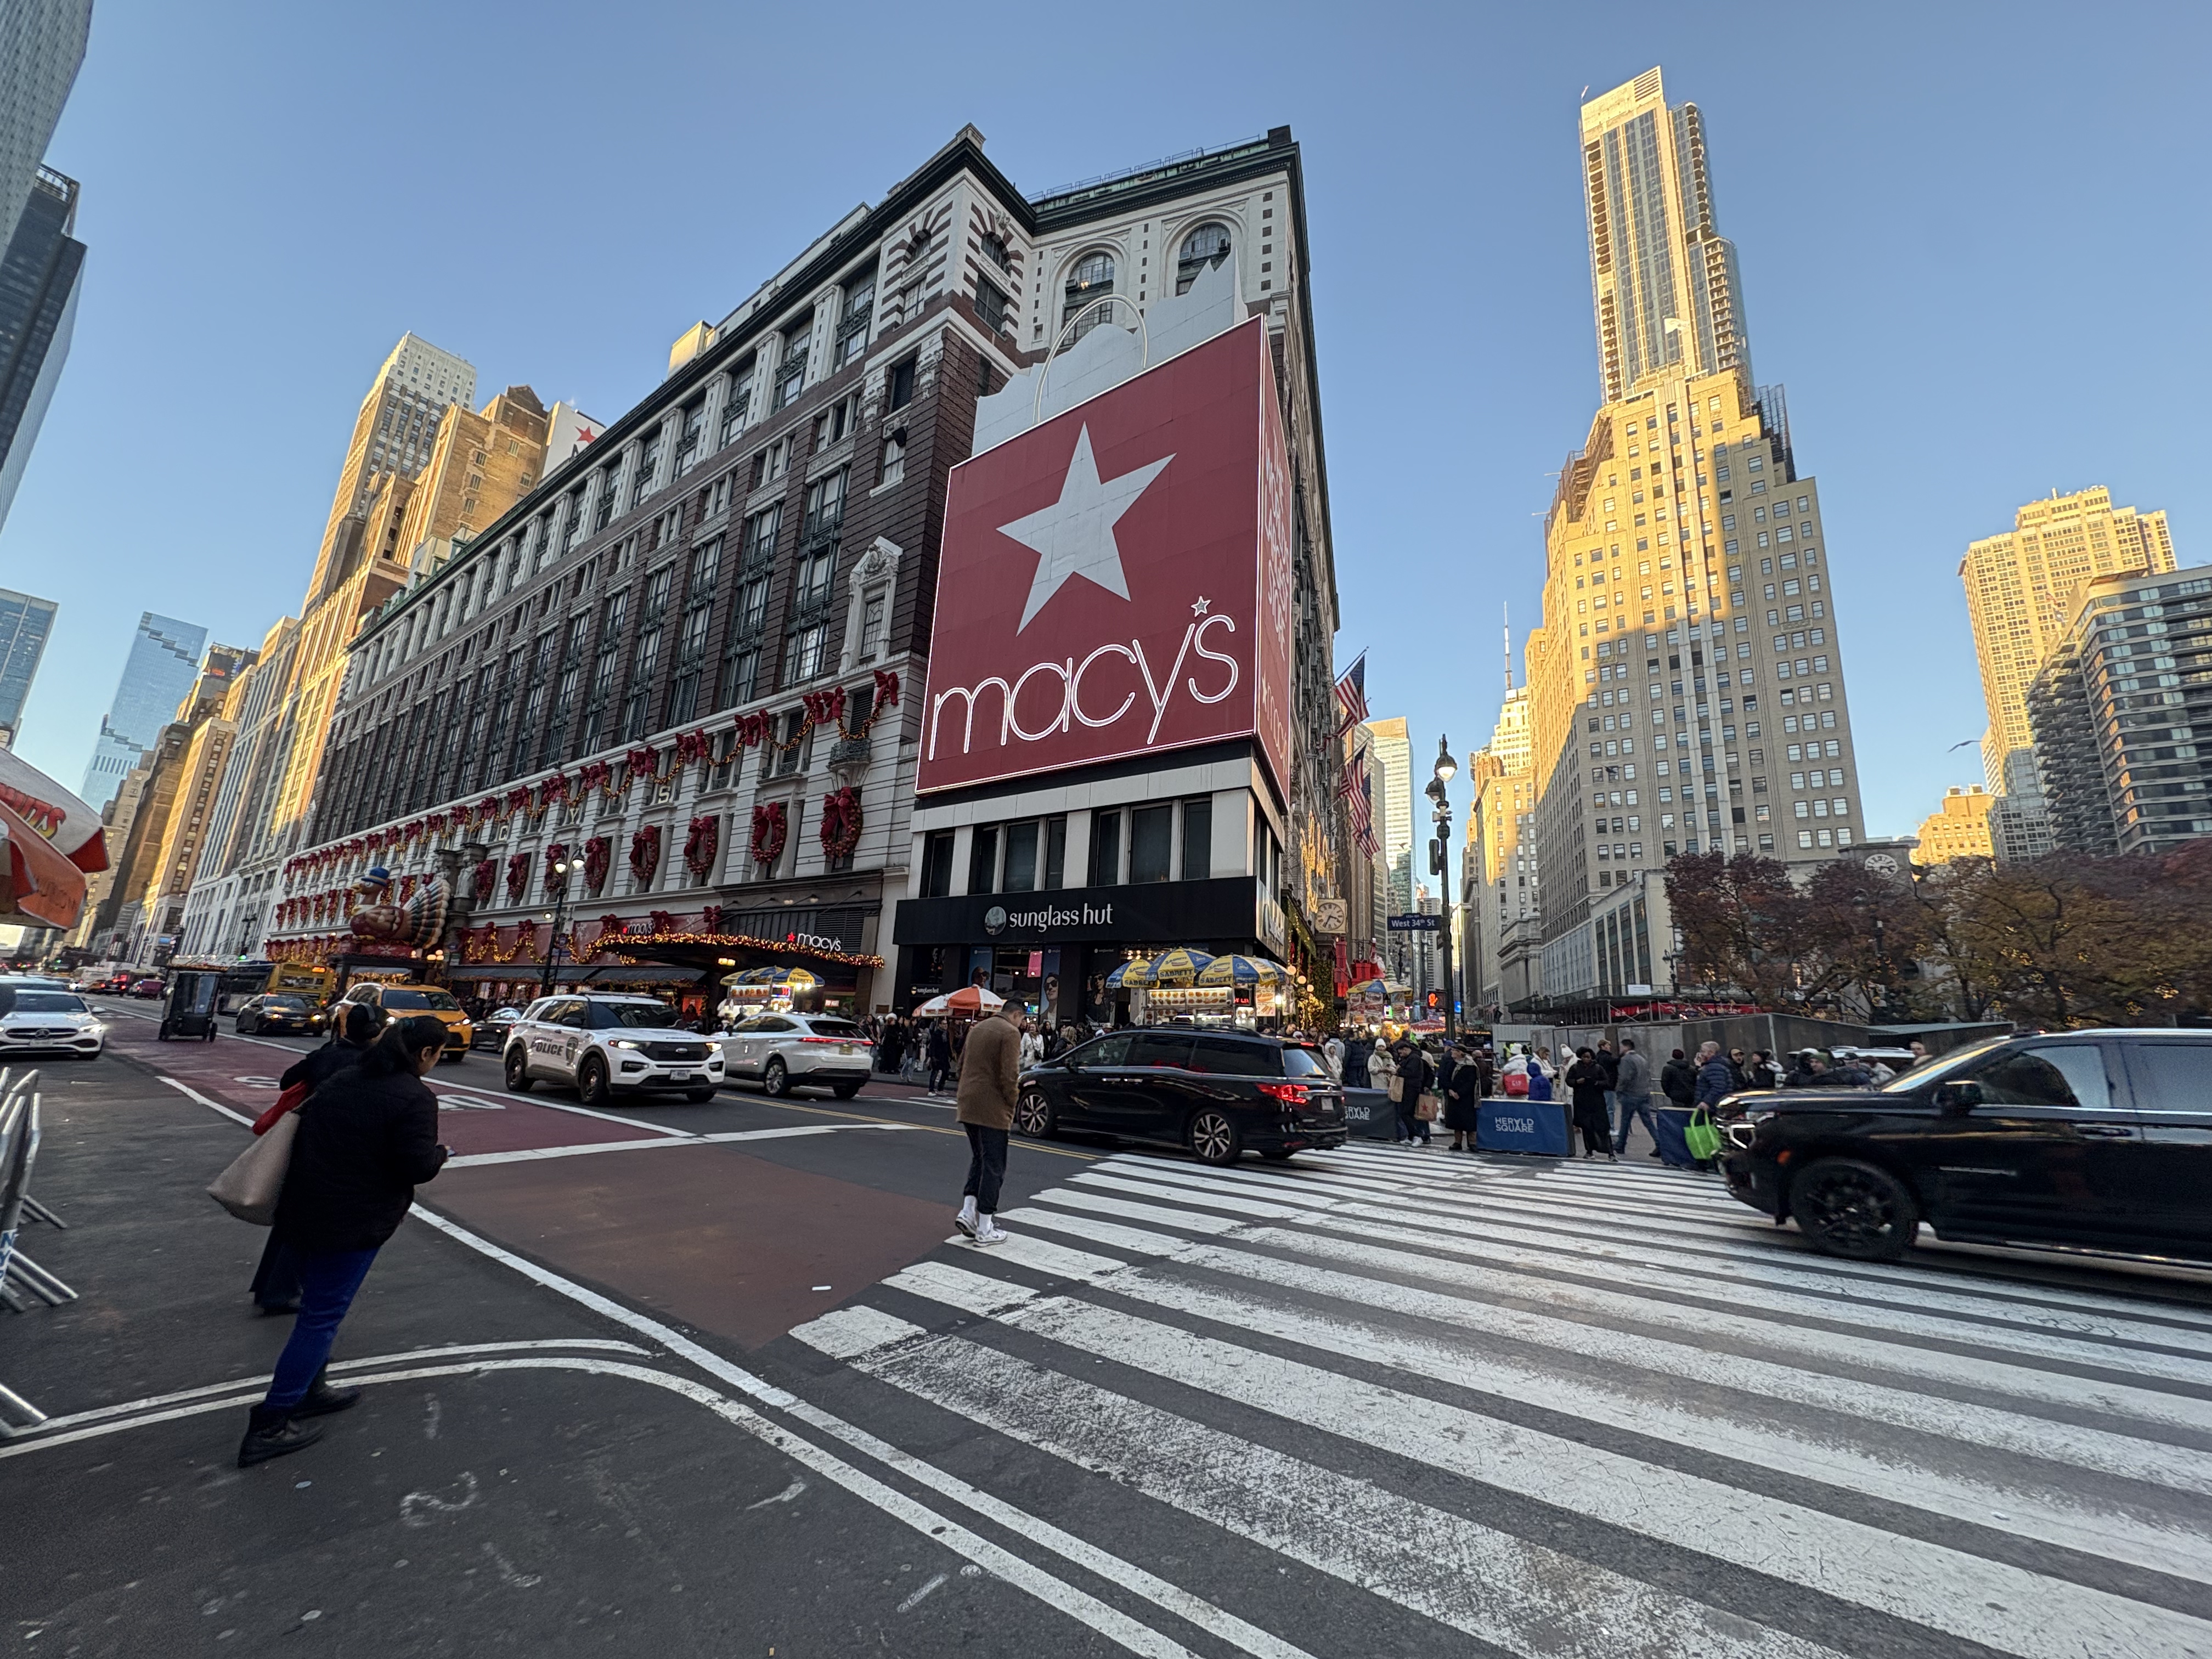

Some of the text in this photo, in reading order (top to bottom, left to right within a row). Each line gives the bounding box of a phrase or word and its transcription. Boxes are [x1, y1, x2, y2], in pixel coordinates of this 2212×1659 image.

[928, 596, 1239, 761] macy's
[1009, 902, 1113, 933] sunglass hut
[1412, 918, 1425, 927] 34th
[1427, 918, 1435, 927] St
[1160, 969, 1193, 978] SABRETT
[530, 1040, 564, 1056] POLICE
[1344, 1105, 1370, 1114] ERALD
[1494, 1116, 1534, 1126] HERALD
[1496, 1124, 1535, 1133] SQUARE
